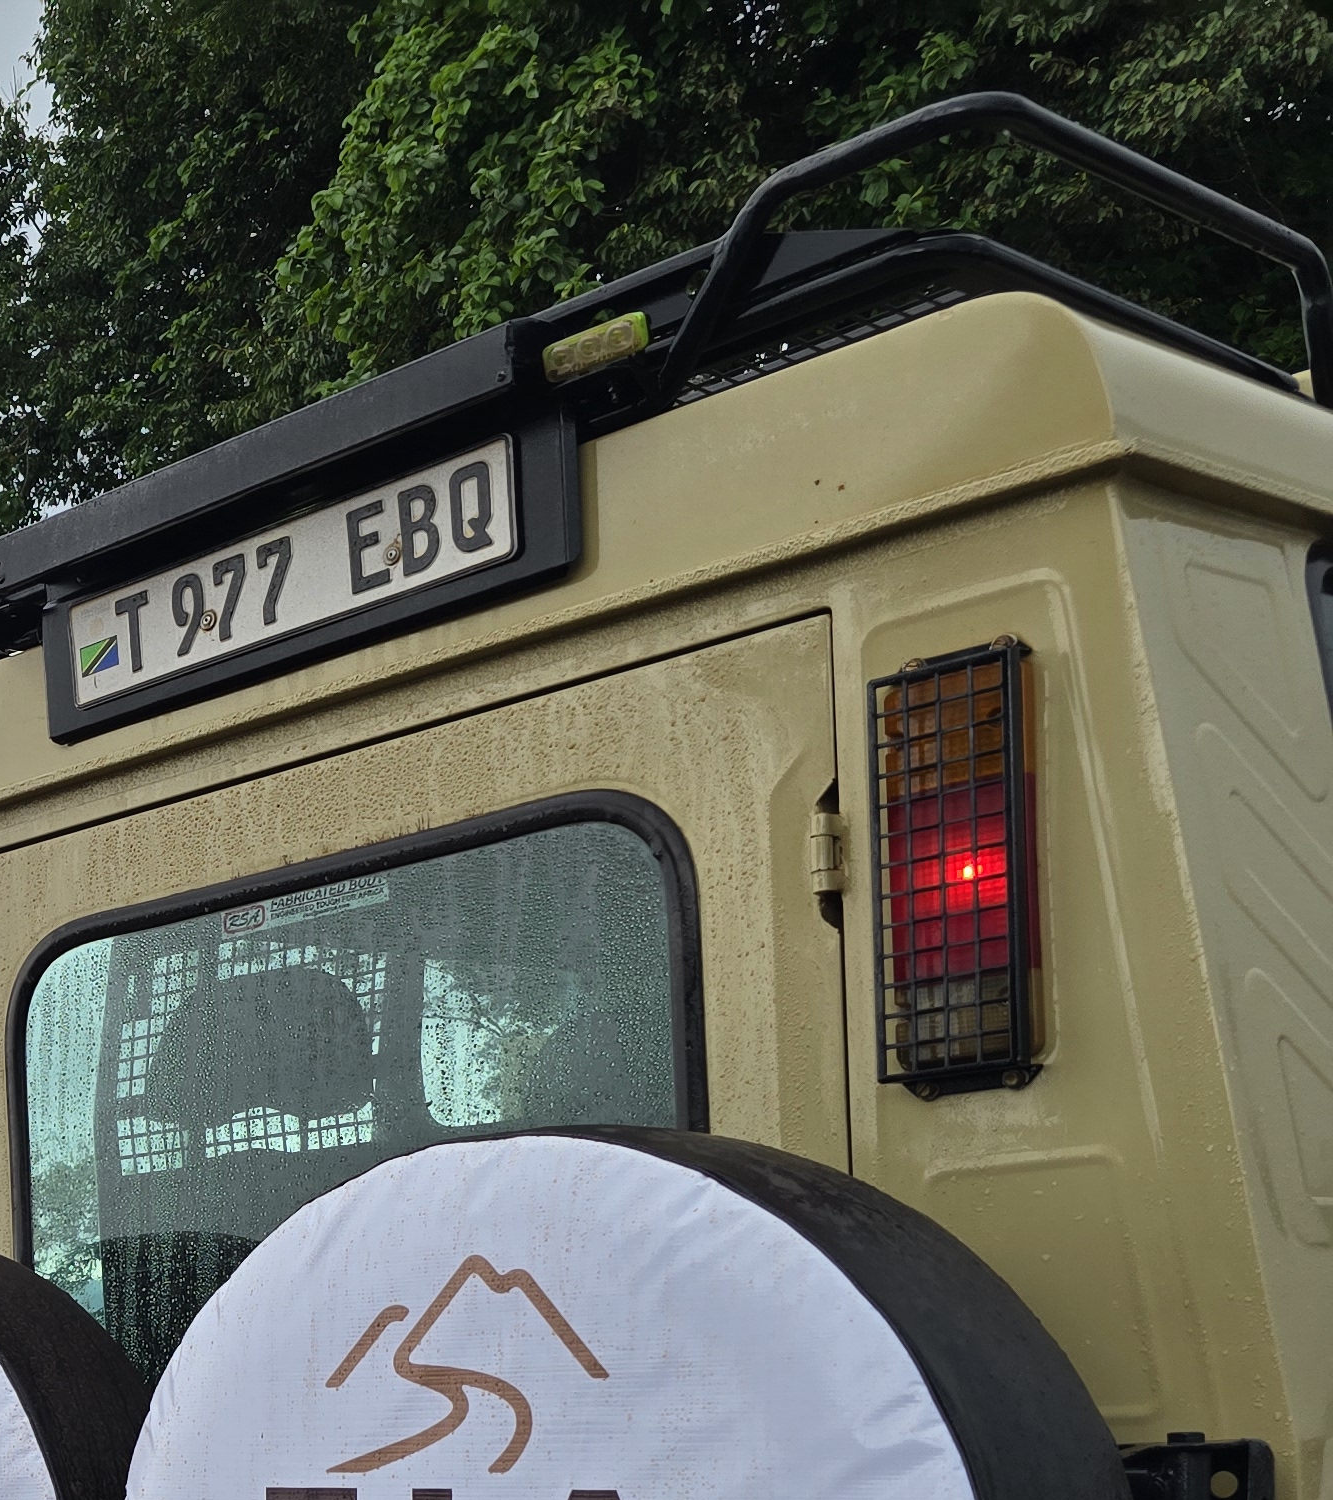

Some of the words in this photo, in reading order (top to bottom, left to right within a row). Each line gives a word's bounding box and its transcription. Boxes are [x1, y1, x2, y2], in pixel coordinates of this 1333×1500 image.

[114, 589, 150, 673] T
[171, 536, 293, 657] 977
[345, 461, 494, 595] EBQ
[270, 883, 346, 910] FABRICATED
[227, 908, 262, 930] RSA
